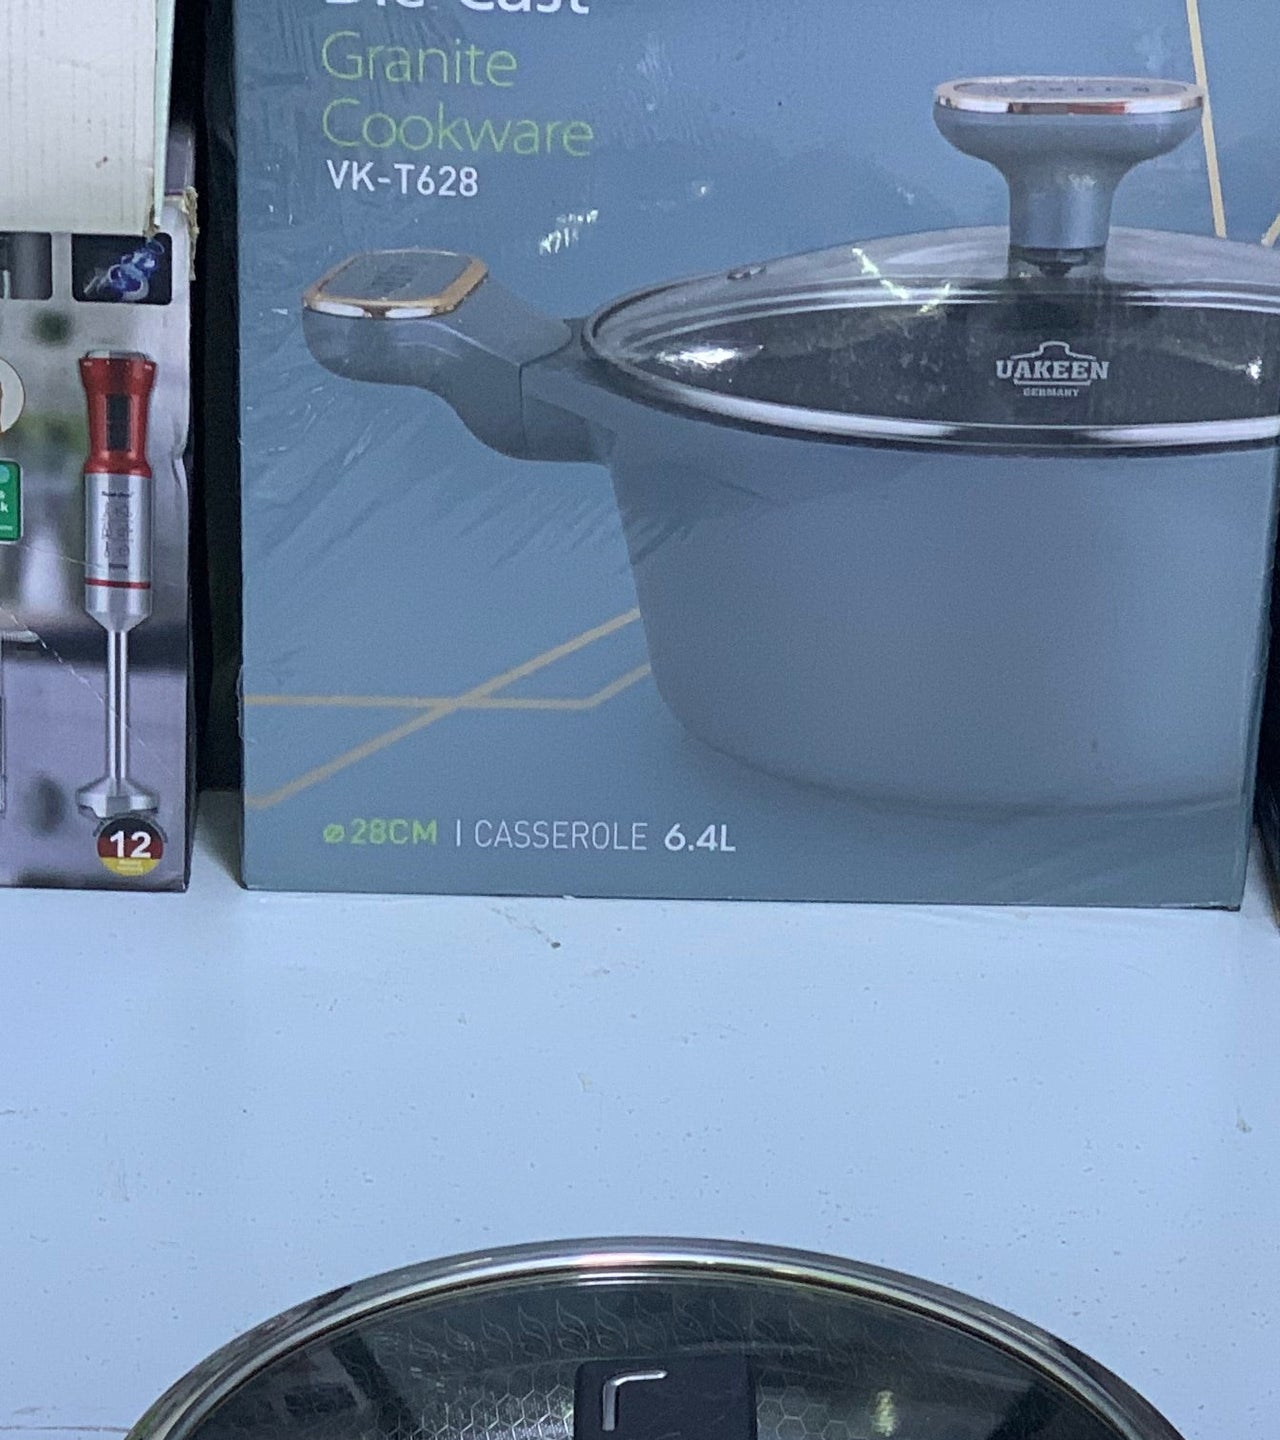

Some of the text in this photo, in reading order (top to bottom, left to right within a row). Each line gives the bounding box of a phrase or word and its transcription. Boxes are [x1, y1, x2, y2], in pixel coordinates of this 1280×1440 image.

[322, 30, 517, 87] Granite
[322, 98, 594, 156] Cookware
[326, 160, 478, 197] VK-T628
[996, 360, 1110, 379] UAKEEN
[1023, 387, 1079, 397] GERMANY
[110, 830, 152, 858] 12
[474, 819, 648, 851] CASSEROLE
[664, 822, 736, 853] 6.4L
